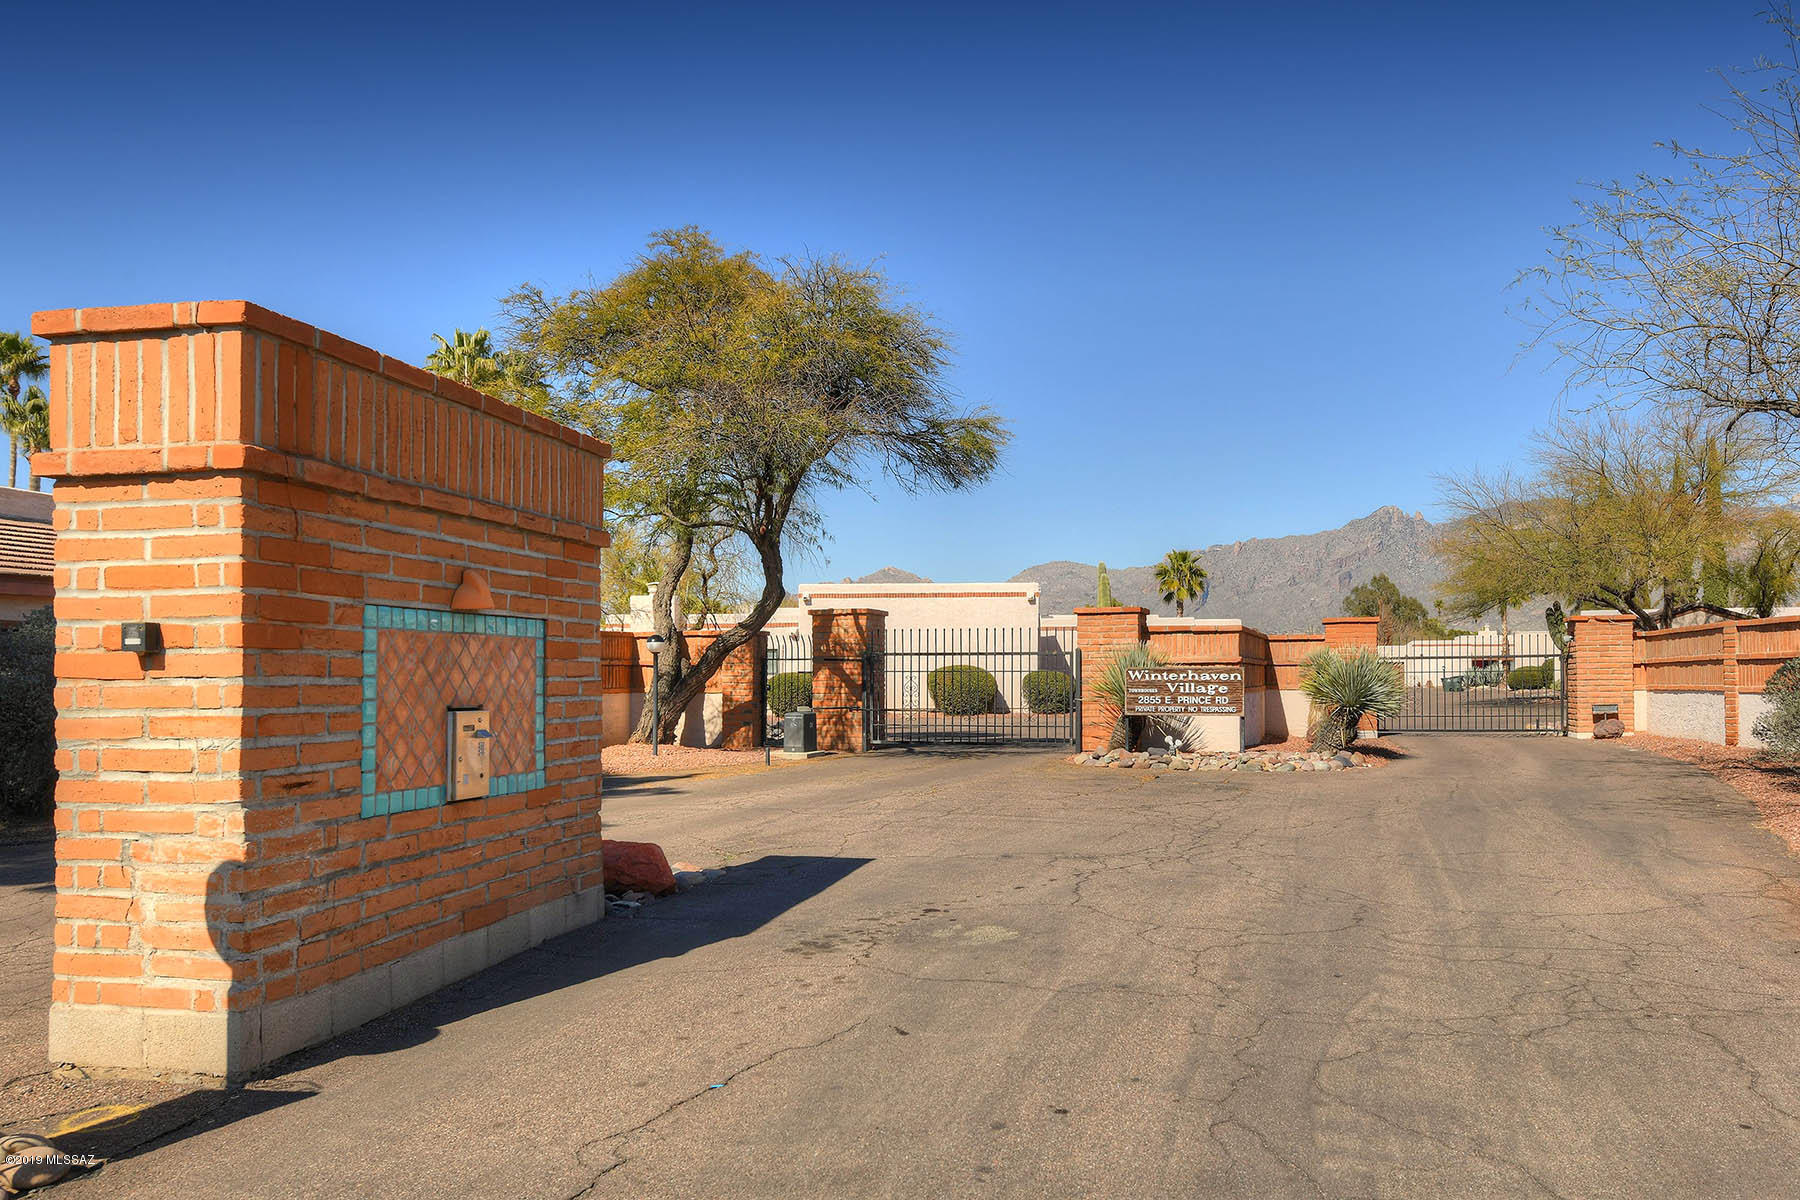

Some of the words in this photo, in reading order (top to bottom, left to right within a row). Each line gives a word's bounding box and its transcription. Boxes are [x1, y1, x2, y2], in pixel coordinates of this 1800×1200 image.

[1127, 670, 1242, 681] Winterhaven
[1166, 682, 1229, 695] Village
[1138, 696, 1161, 705] 2855
[1165, 696, 1174, 705] E.
[1177, 696, 1211, 705] PRINCE
[1215, 696, 1229, 705] RD
